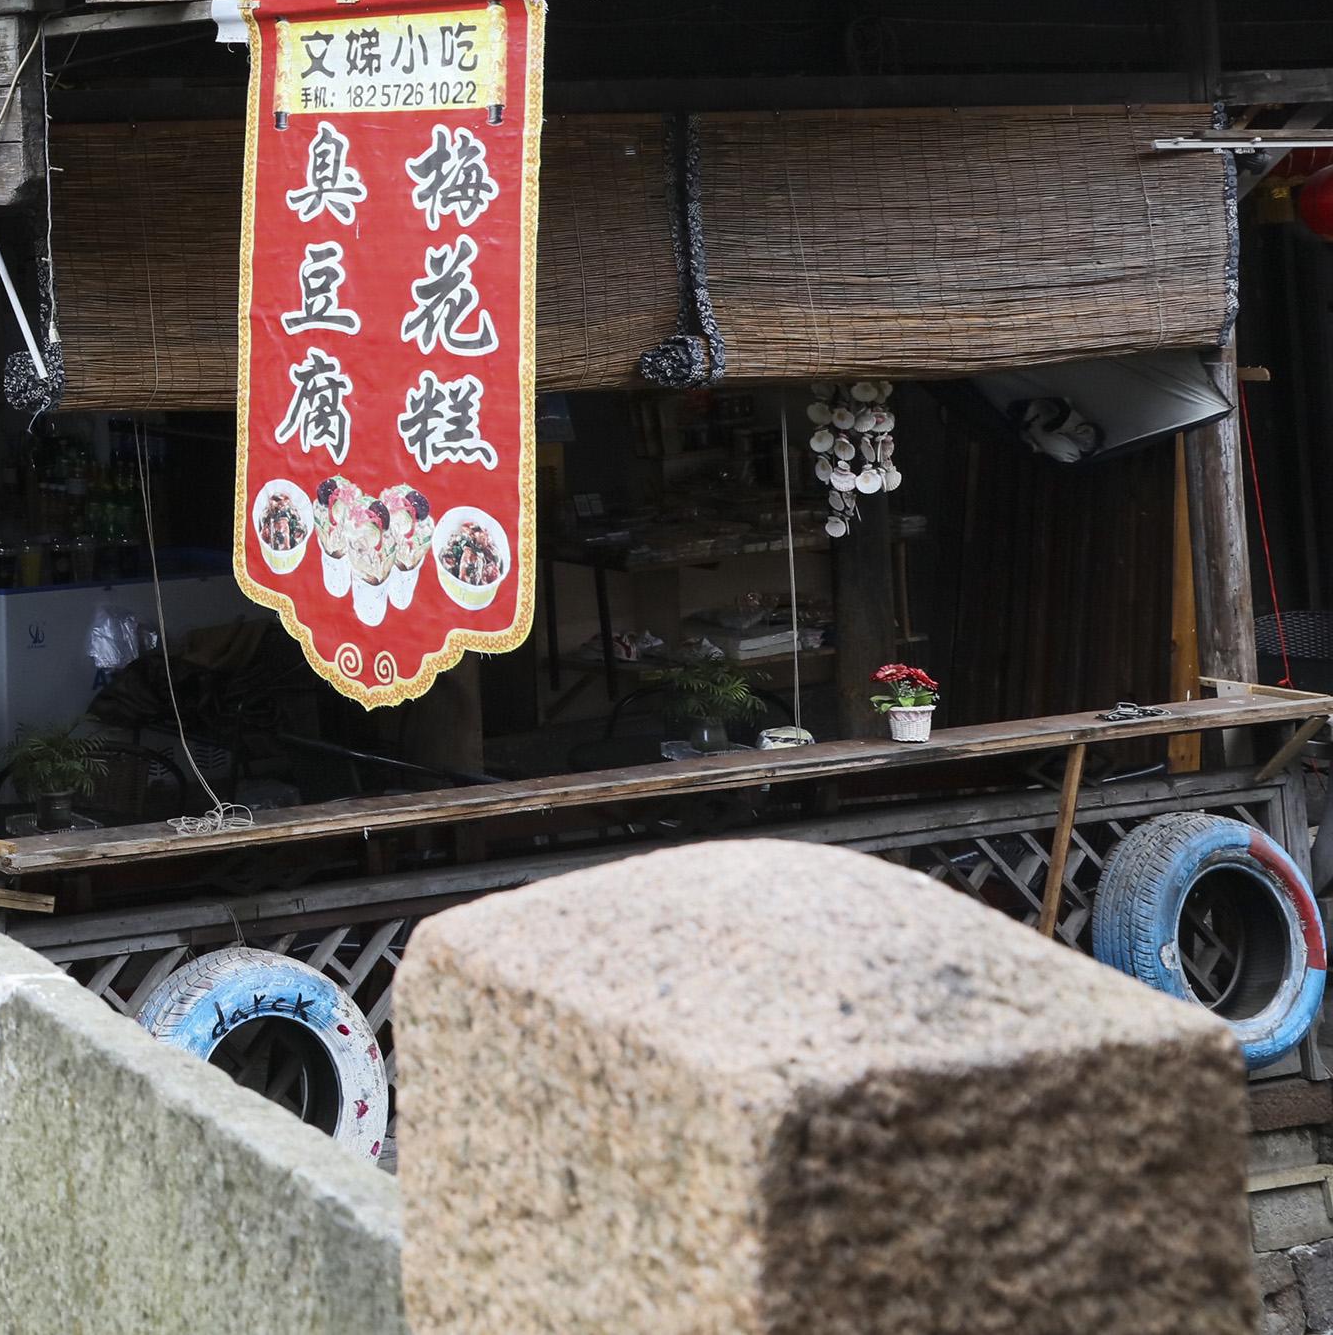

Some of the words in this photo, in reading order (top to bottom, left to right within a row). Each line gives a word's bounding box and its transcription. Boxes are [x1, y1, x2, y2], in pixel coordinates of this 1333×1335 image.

[300, 22, 479, 79] 文娣小吃
[276, 122, 366, 464] 臭豆腐
[397, 124, 499, 471] 梅花糕
